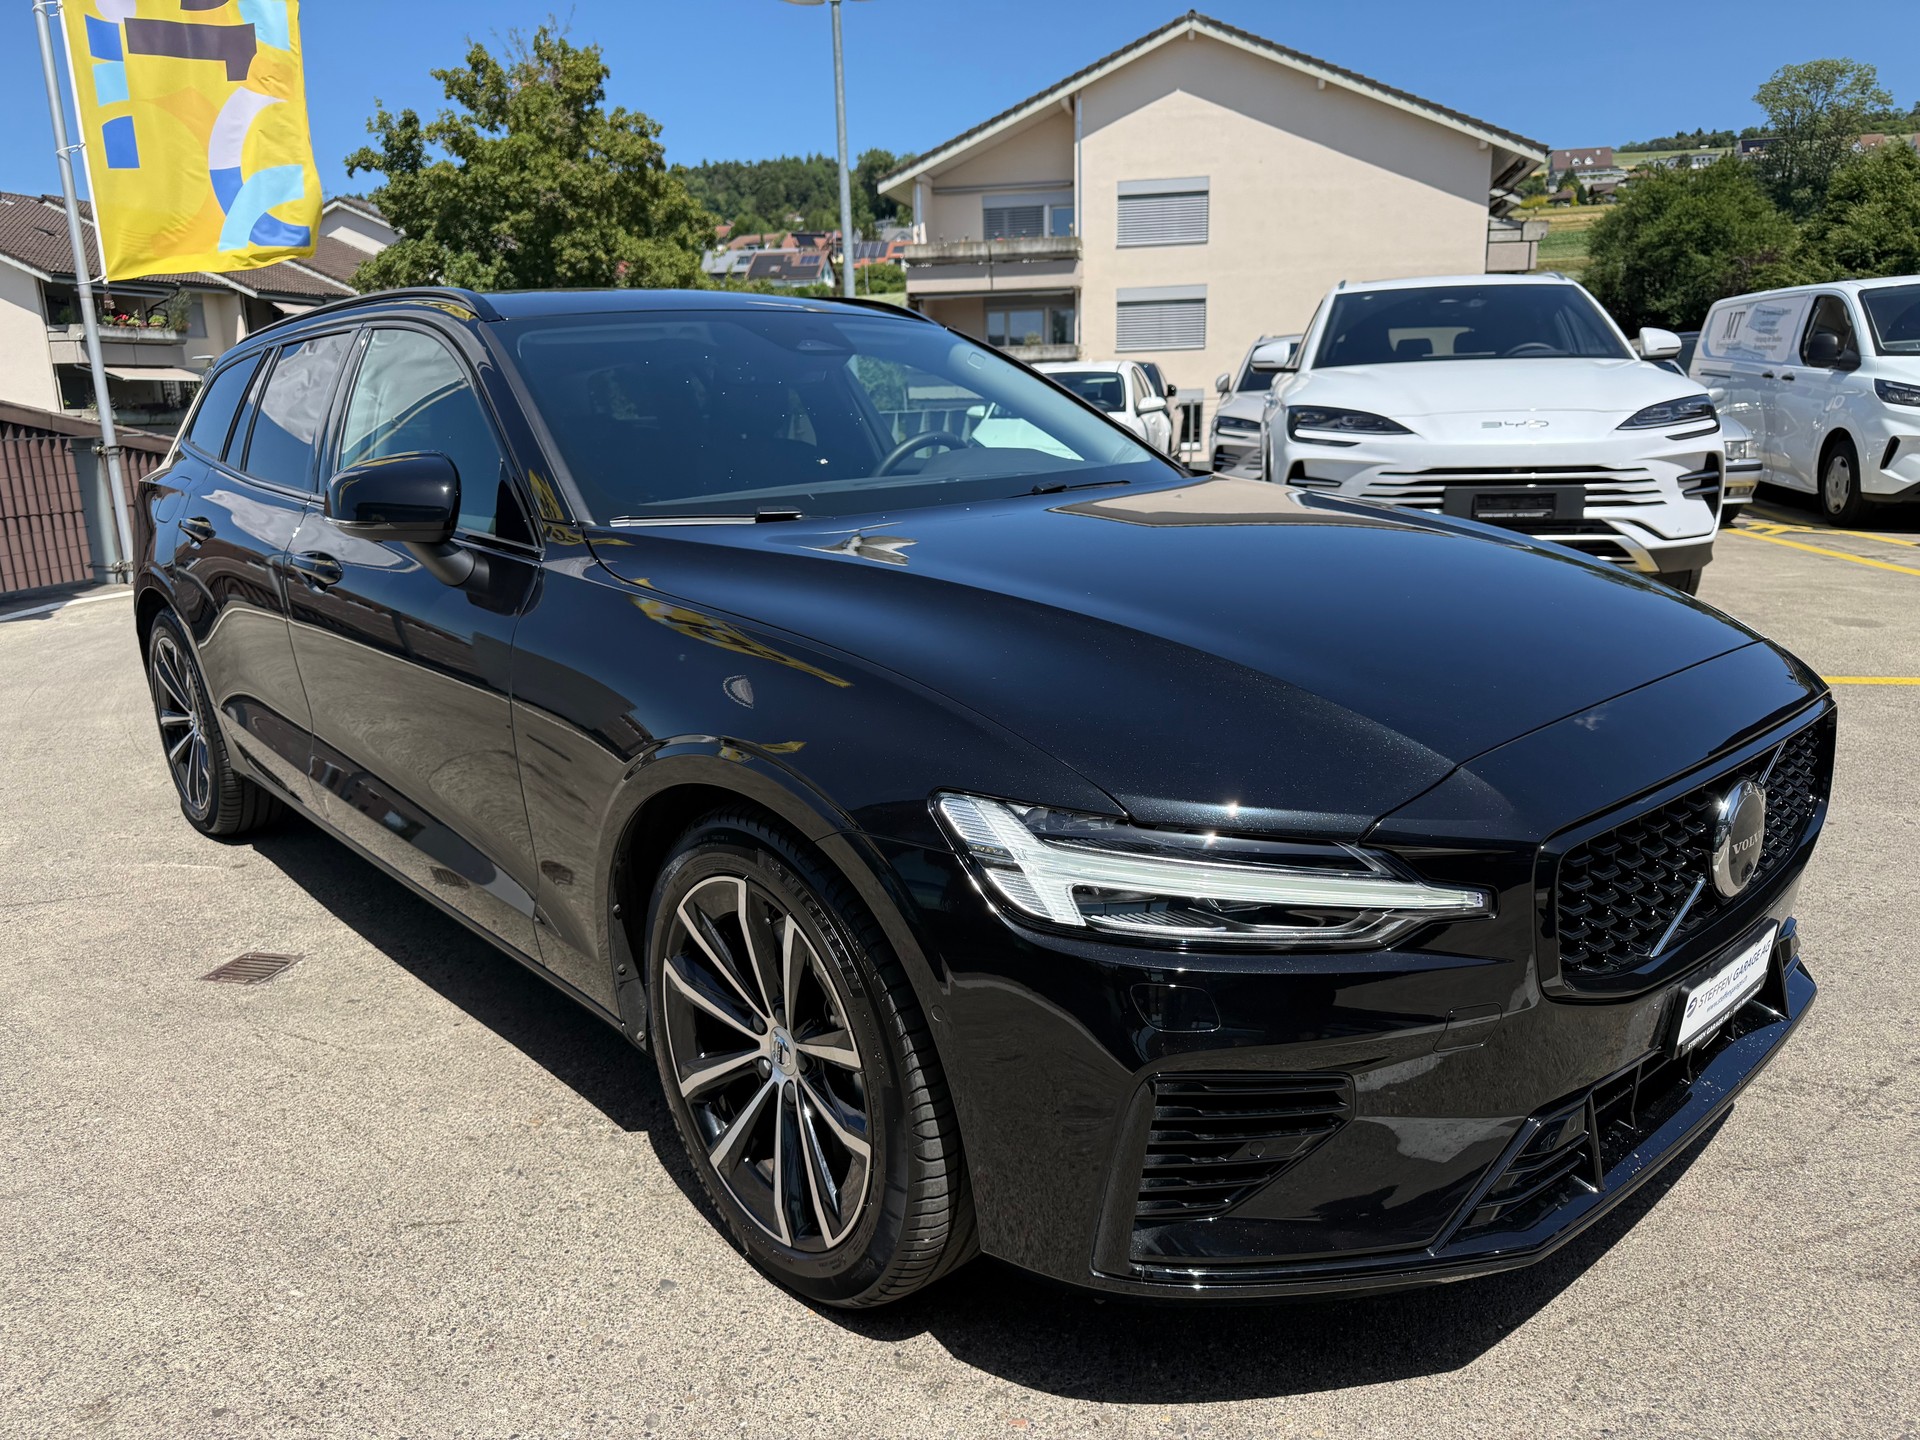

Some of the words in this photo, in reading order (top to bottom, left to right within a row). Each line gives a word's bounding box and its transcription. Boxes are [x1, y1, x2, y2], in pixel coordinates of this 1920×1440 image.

[1481, 420, 1549, 428] BYD
[1732, 830, 1762, 854] VOLV
[1698, 973, 1733, 1008] STEFFEN
[1733, 949, 1761, 981] GARAGE
